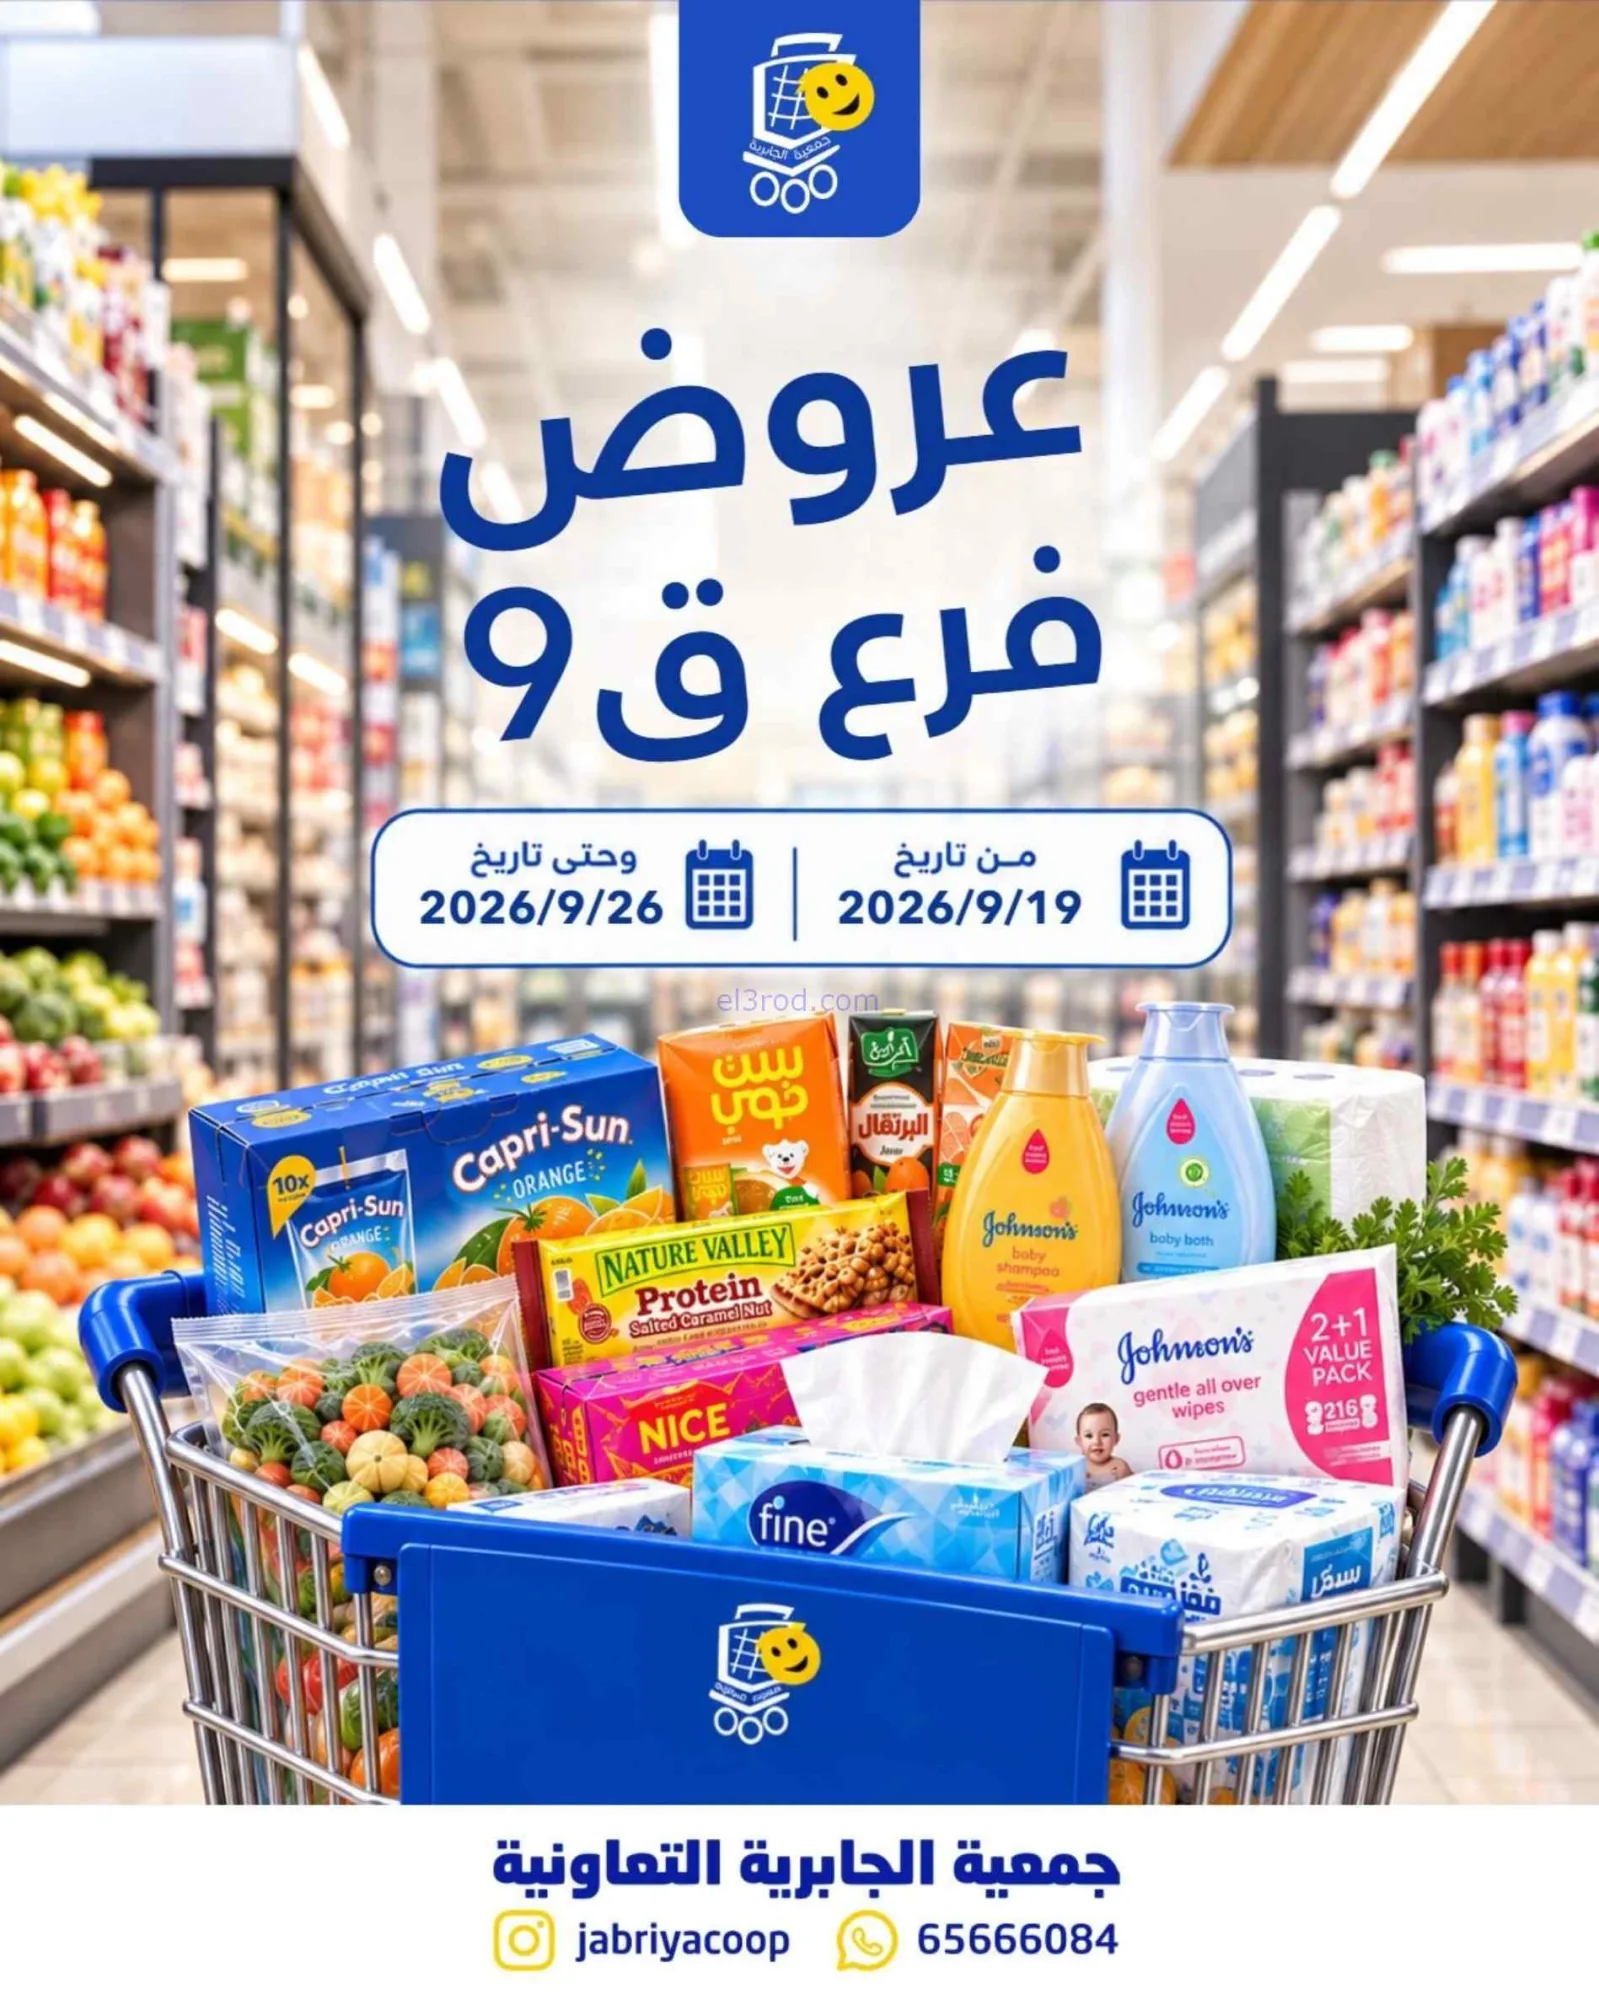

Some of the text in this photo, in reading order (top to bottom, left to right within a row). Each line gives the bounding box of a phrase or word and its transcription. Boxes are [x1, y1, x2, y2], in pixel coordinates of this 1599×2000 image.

[452, 1105, 631, 1192] Capri-Sun
[272, 1173, 310, 1195] 10x
[512, 1160, 586, 1199] ORANGE
[300, 1195, 404, 1248] Capri-Sun
[602, 1227, 787, 1288] NATURE VALLEY
[635, 1273, 763, 1316] Protein
[630, 1315, 678, 1337] Salted
[679, 1304, 740, 1328] Caramel
[741, 1300, 772, 1319] Nut
[1310, 1307, 1368, 1342] 2+1
[1303, 1340, 1373, 1365] VALUE
[1133, 1376, 1262, 1408] gentle all over
[1312, 1361, 1373, 1387] PACK
[1171, 1400, 1225, 1421] wipes
[1323, 1398, 1359, 1419] 216
[638, 1402, 730, 1455] NICE
[758, 1495, 829, 1547] fine
